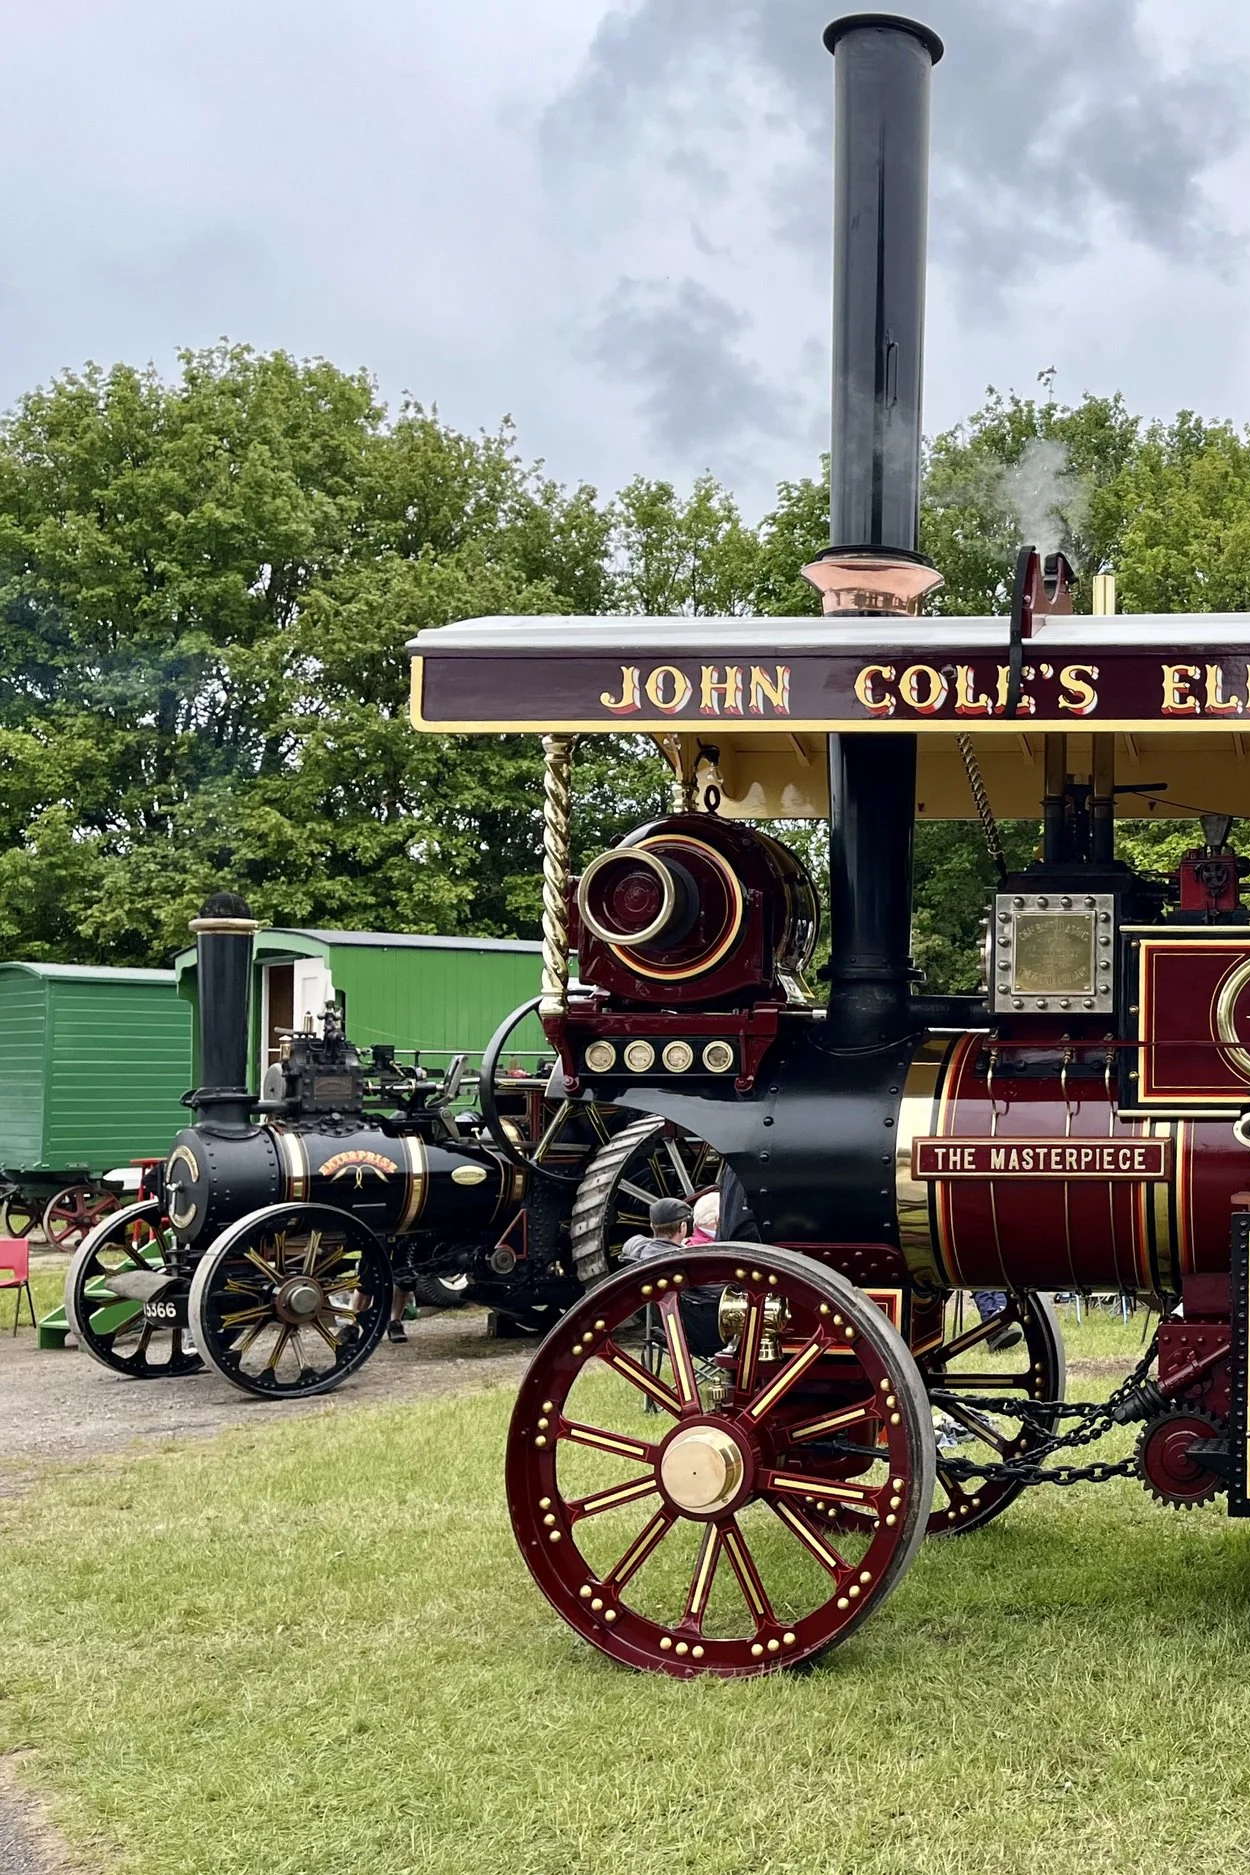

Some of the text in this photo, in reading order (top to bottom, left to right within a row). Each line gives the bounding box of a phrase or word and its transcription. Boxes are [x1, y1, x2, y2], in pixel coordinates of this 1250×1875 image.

[600, 664, 791, 716] JOHN
[854, 663, 1099, 719] COLE'S
[318, 1150, 398, 1176] ENTERPRISE
[934, 1148, 1146, 1170] THE MASTERPIECE
